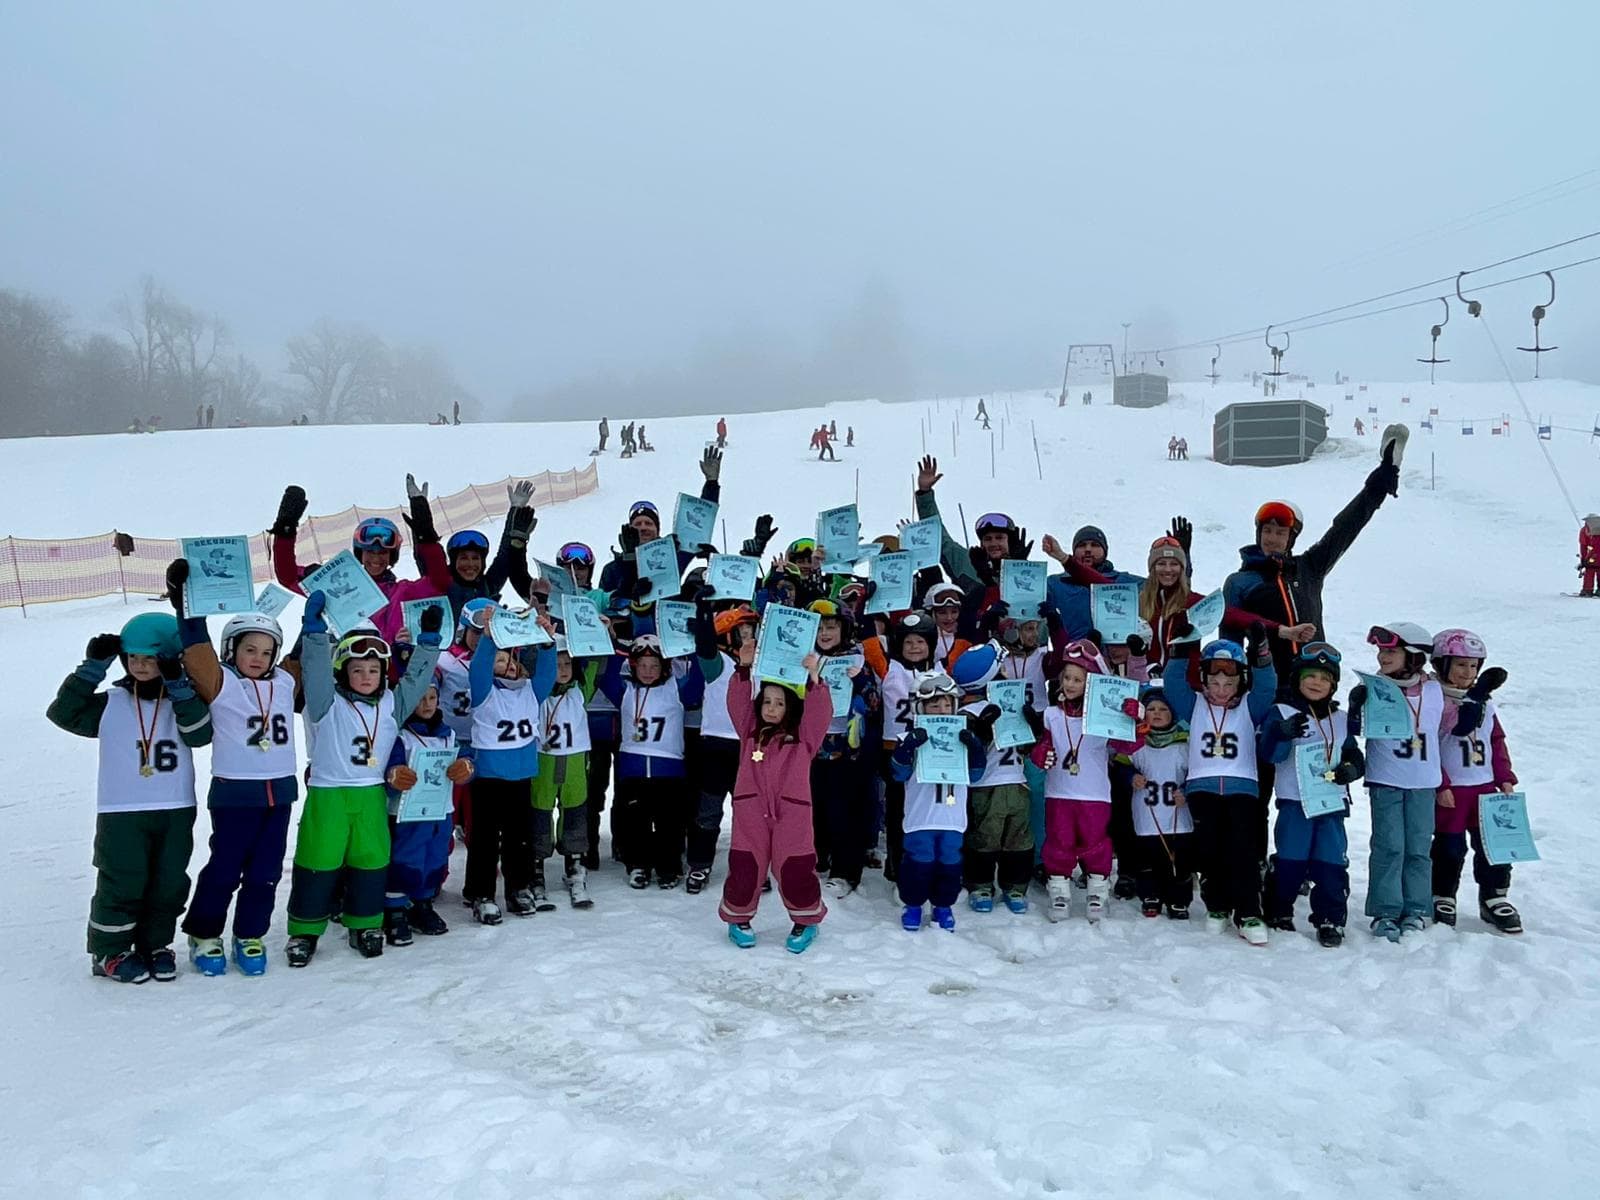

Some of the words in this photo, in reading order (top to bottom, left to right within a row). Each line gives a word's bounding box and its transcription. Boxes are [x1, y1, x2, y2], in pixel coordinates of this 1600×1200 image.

[247, 714, 289, 746] 26
[497, 719, 533, 742] 20
[546, 722, 573, 749] 21
[632, 717, 666, 742] 37
[136, 739, 178, 776] 16
[351, 736, 371, 766] 3
[1200, 732, 1239, 760] 36
[1392, 733, 1427, 761] 31
[1144, 780, 1178, 807] 30
